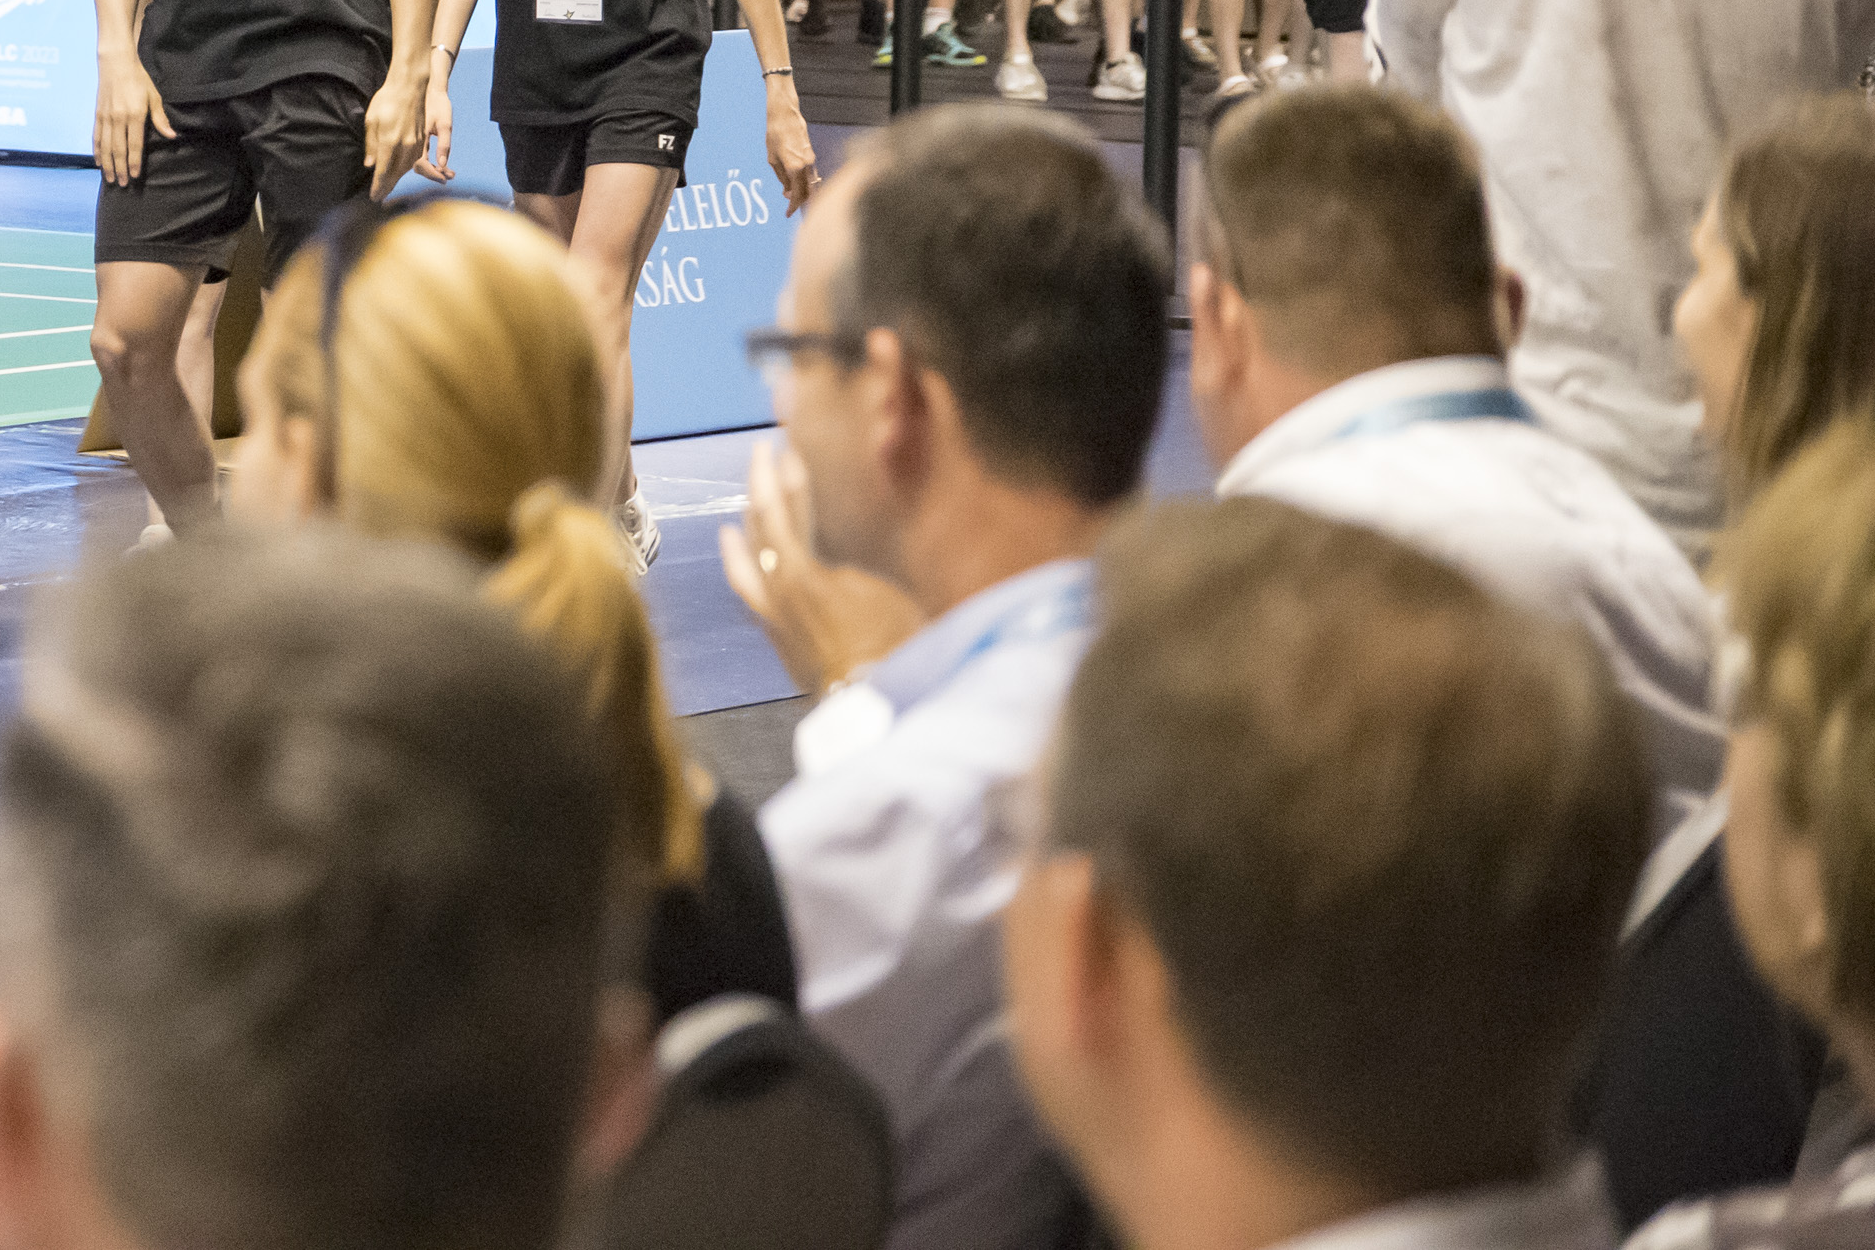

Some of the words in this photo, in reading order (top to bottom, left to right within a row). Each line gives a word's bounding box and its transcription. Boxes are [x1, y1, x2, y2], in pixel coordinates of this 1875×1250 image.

[658, 133, 675, 151] FZ
[664, 168, 770, 233] ELELŐS
[633, 245, 706, 308] SÁG
